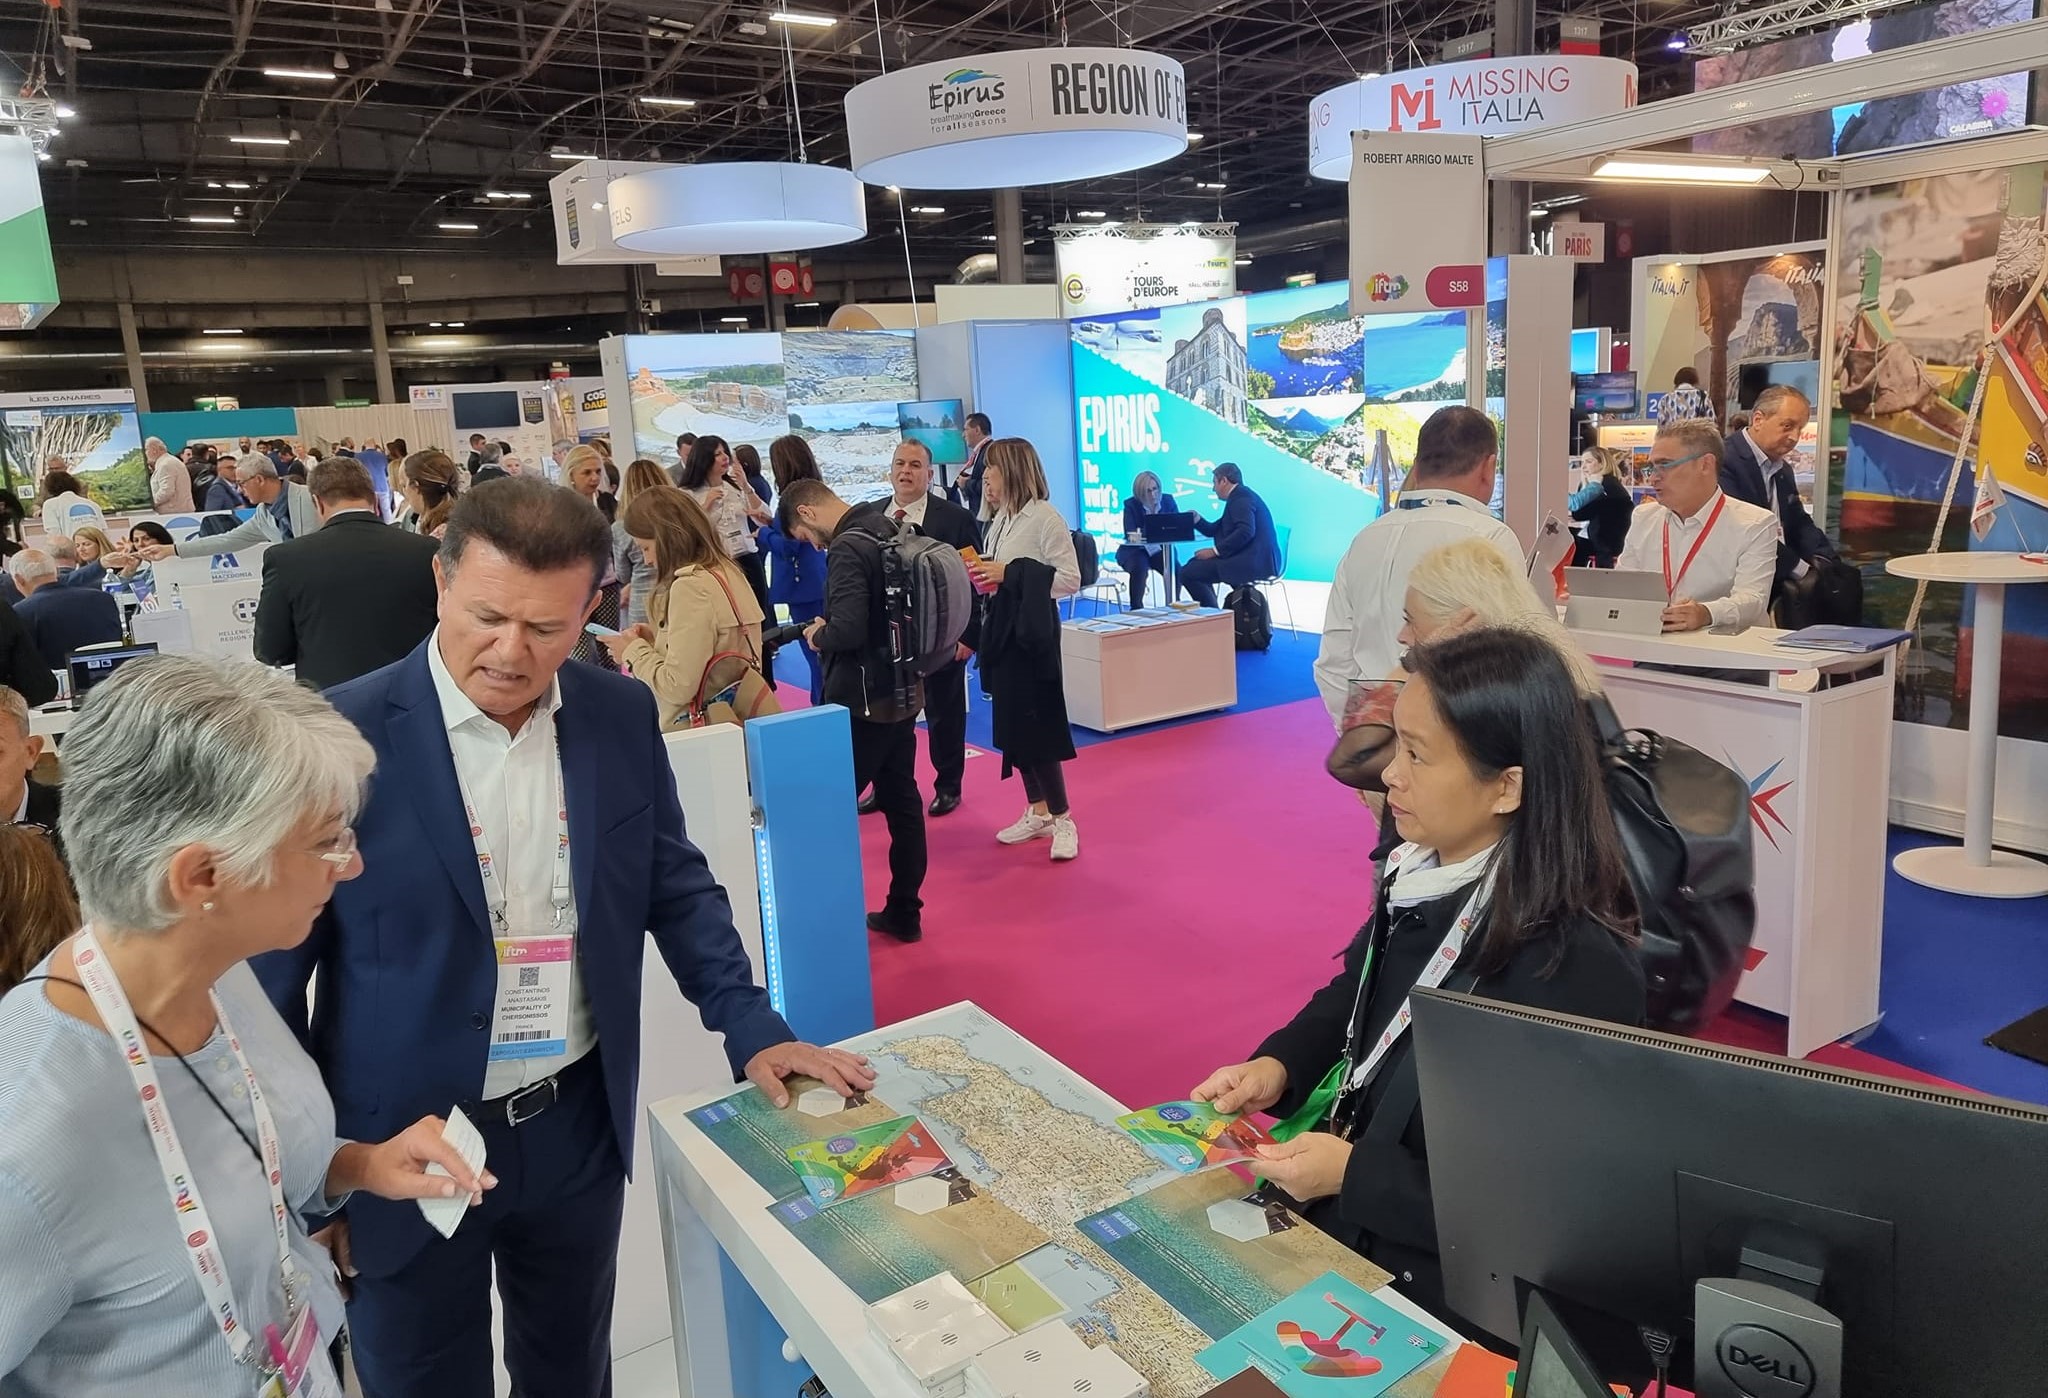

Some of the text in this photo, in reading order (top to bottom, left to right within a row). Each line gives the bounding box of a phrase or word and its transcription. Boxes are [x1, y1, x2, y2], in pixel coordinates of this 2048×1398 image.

[1050, 63, 1149, 116] REGION
[1154, 68, 1171, 120] OF
[1449, 66, 1570, 101] MISSING
[929, 82, 1005, 113] Epirus
[1462, 97, 1544, 126] ITALIA
[1949, 119, 1993, 133] CALABRIA
[1363, 152, 1474, 165] ROBERT ARRIGO MALTE
[1565, 237, 1592, 256] PARIS
[1133, 276, 1164, 287] TOURS
[1133, 286, 1179, 298] D'EUROPE
[1449, 280, 1469, 293] S58
[1079, 393, 1170, 453] EPIRUS.
[1728, 1344, 1806, 1388] DELL
